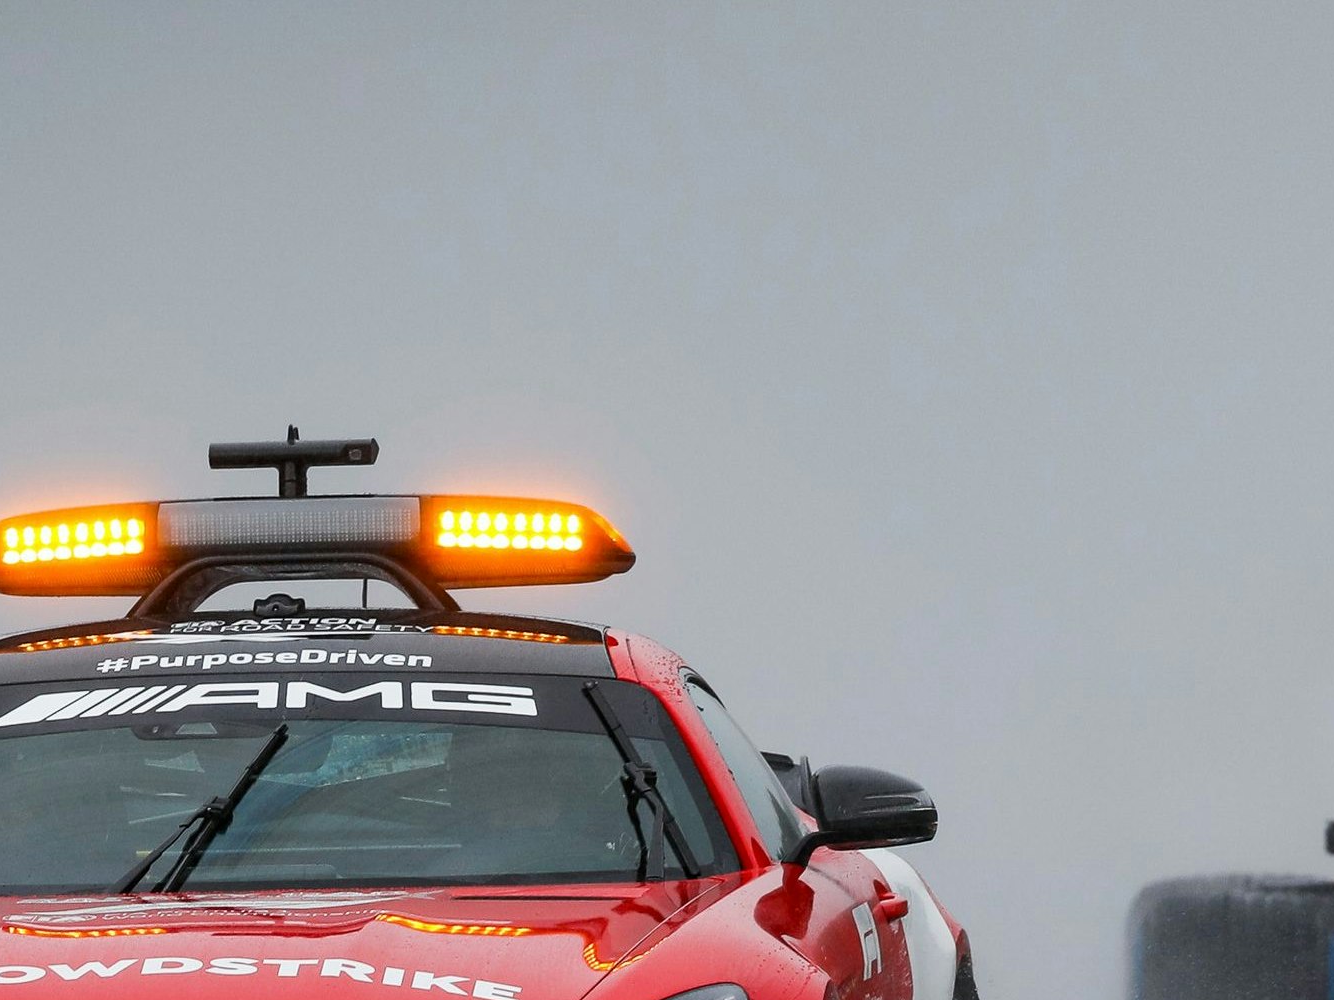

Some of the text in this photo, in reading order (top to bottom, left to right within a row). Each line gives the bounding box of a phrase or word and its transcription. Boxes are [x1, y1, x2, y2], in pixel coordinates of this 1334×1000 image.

[231, 618, 376, 626] ACTION
[220, 624, 306, 632] ROAD
[313, 624, 433, 632] SAFETY
[96, 649, 433, 673] #PurposeDriven
